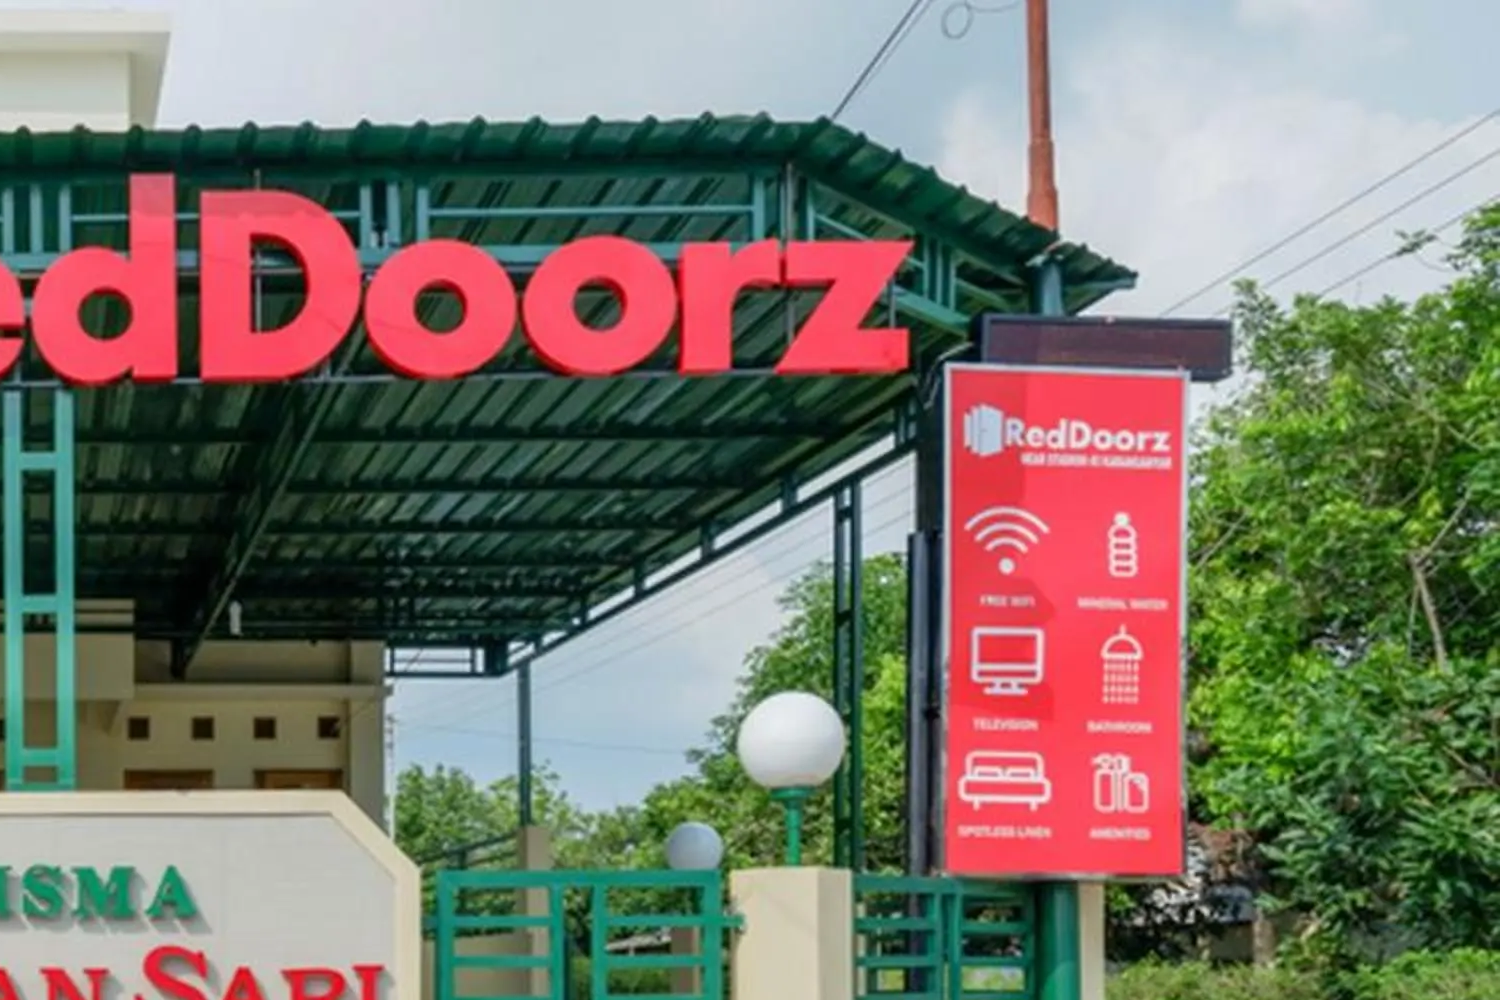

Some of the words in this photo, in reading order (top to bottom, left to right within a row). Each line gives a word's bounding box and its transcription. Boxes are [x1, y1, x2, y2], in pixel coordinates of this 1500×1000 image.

[1006, 417, 1172, 452] RedDoorz
[972, 716, 1039, 732] TELEVISION
[1086, 719, 1153, 734] BATHROOM
[1088, 827, 1152, 842] AMENITIES
